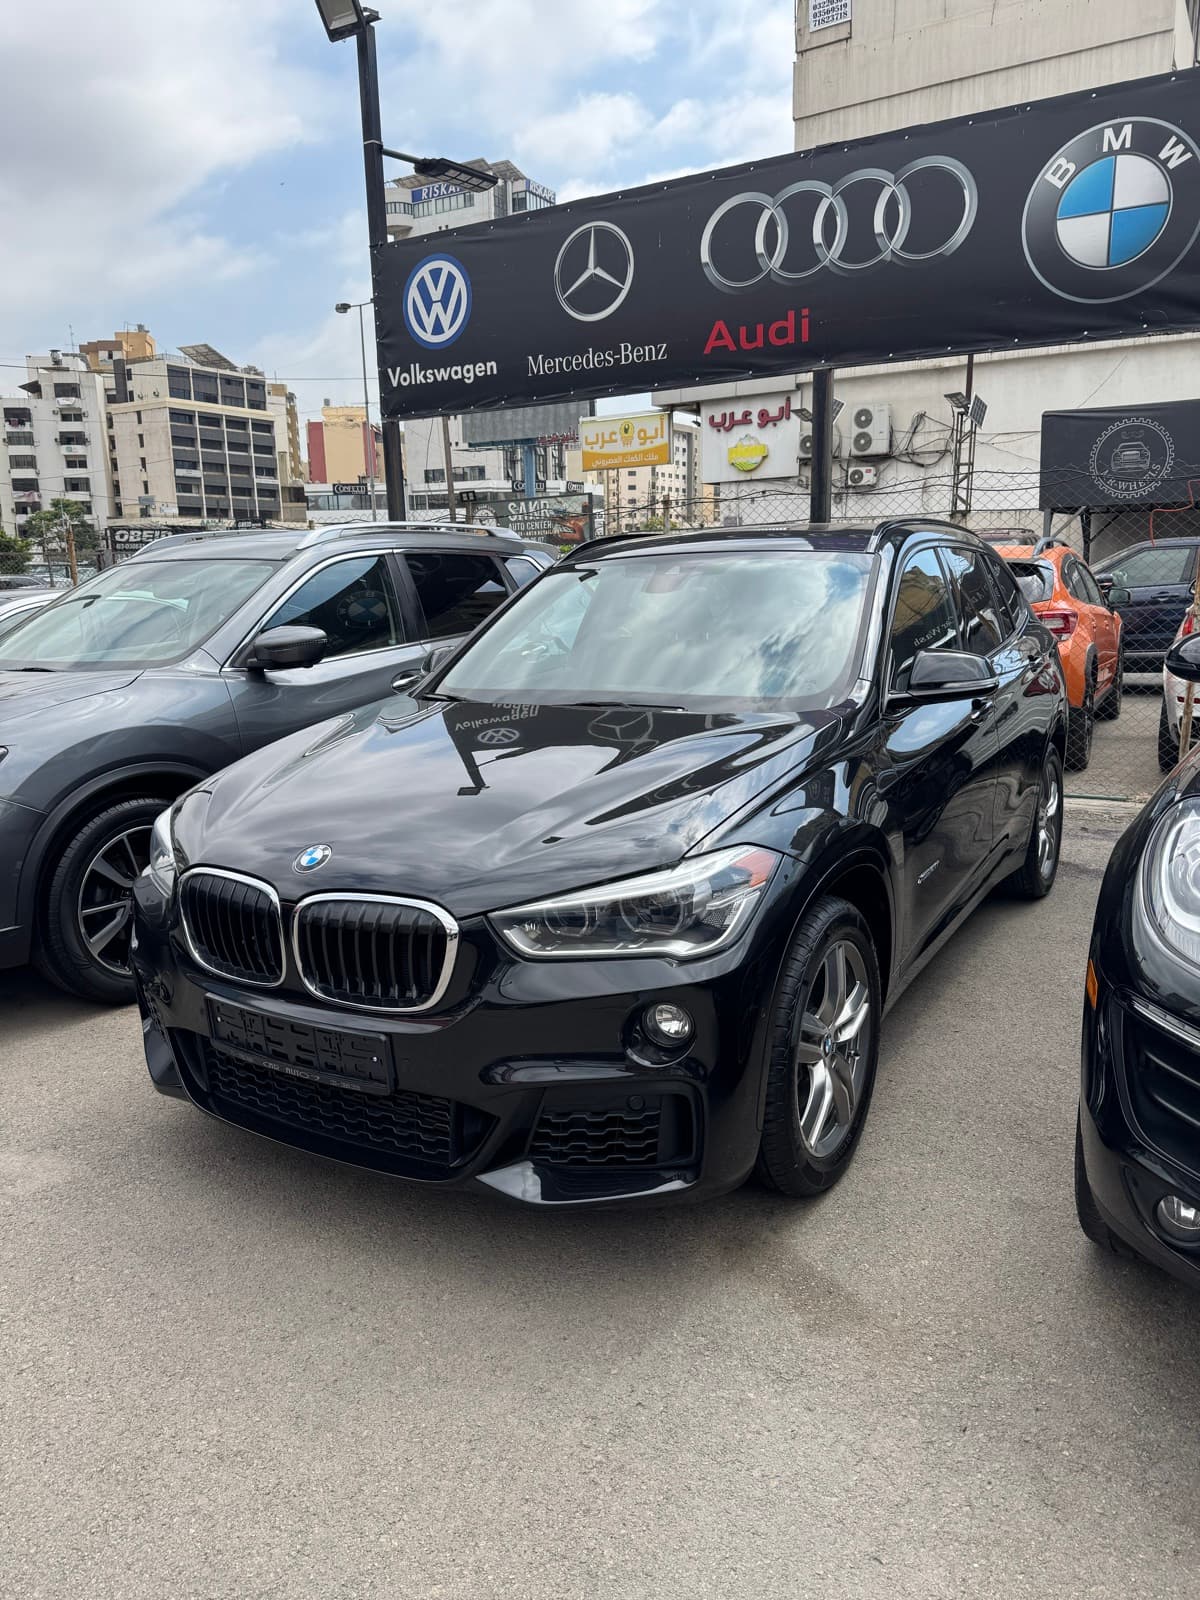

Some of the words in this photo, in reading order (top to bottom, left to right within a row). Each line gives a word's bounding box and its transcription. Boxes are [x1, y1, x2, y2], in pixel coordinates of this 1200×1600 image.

[1044, 124, 1193, 189] BMW
[703, 307, 809, 355] Audi
[387, 360, 498, 388] Volkswagen
[527, 342, 668, 377] Mercedes-Benz
[708, 410, 753, 433] عرب
[757, 396, 791, 429] أبو
[584, 430, 618, 449] عرب
[637, 415, 665, 445] أبو
[508, 501, 550, 522] SAKR
[527, 521, 552, 530] CENTER
